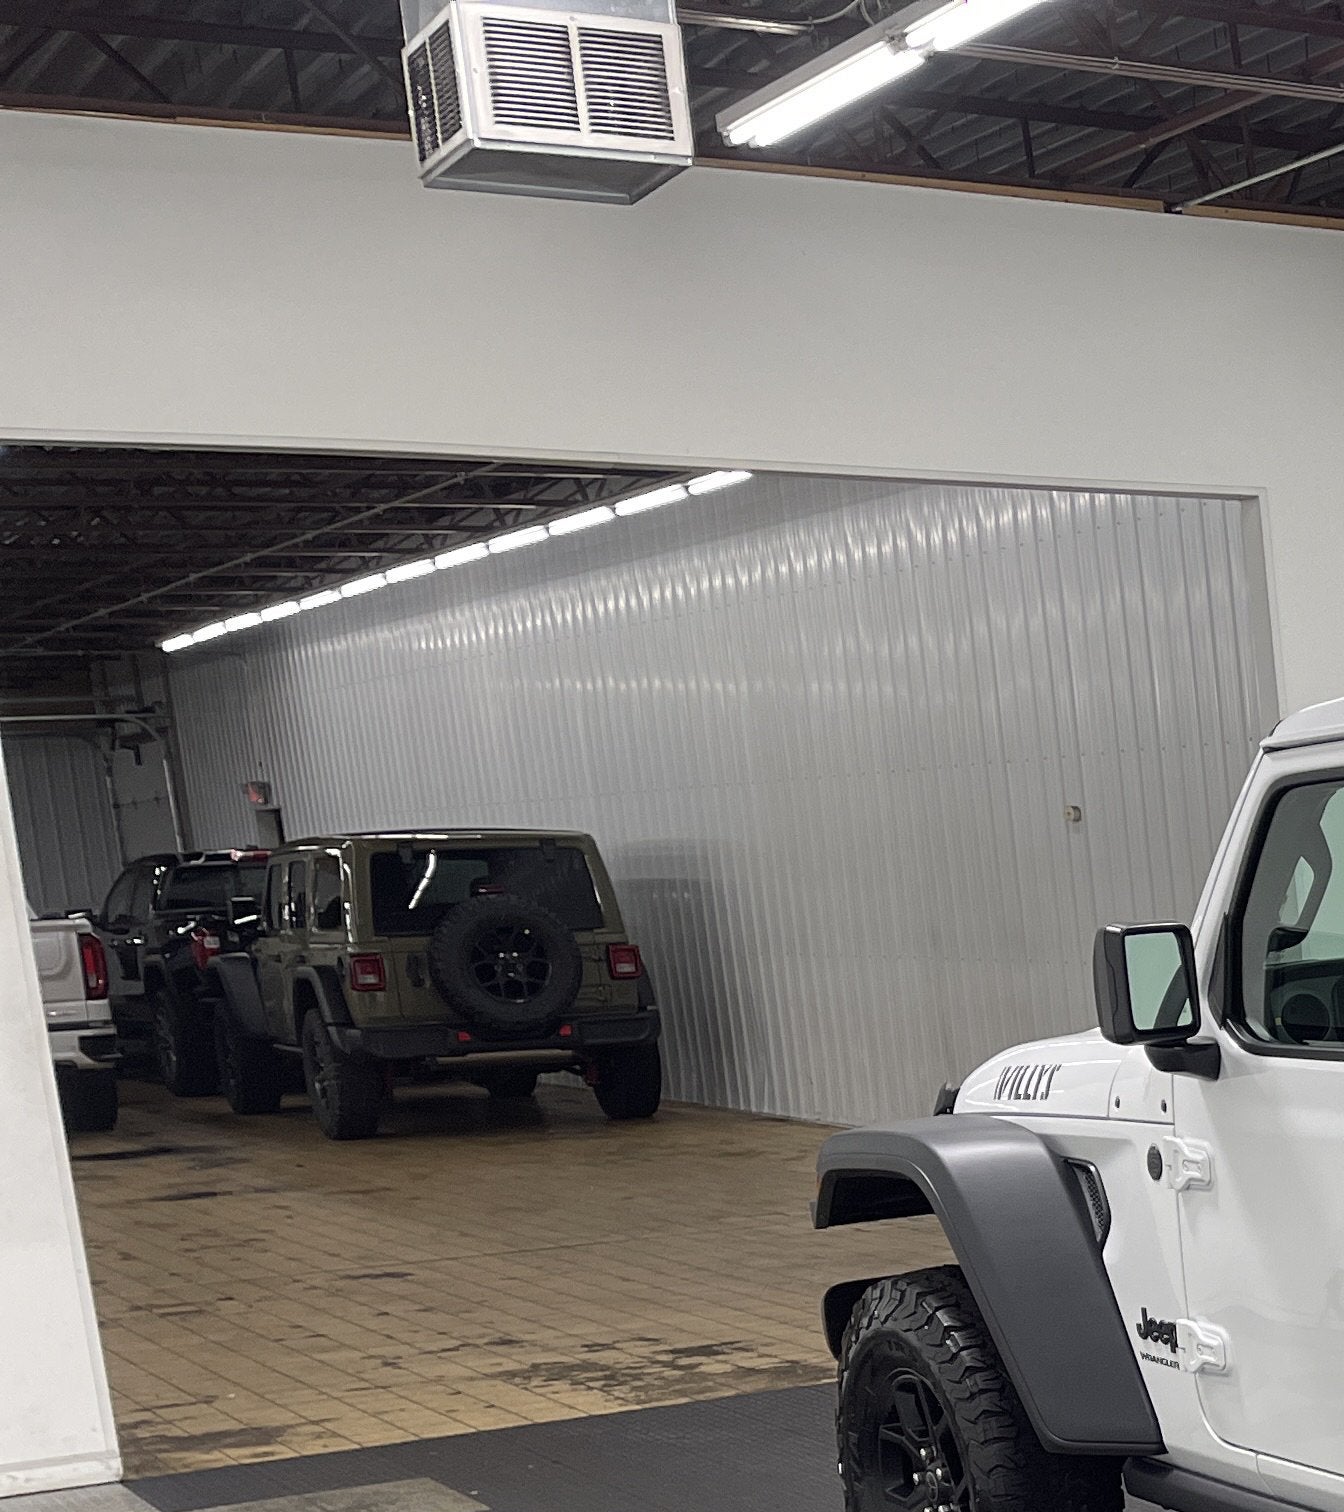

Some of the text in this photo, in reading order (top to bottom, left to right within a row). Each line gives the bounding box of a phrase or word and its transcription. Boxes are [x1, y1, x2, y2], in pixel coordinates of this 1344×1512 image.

[993, 1064, 1061, 1101] WILLYS
[1136, 1307, 1178, 1353] Jeep
[1140, 1351, 1180, 1371] WRANGLER
